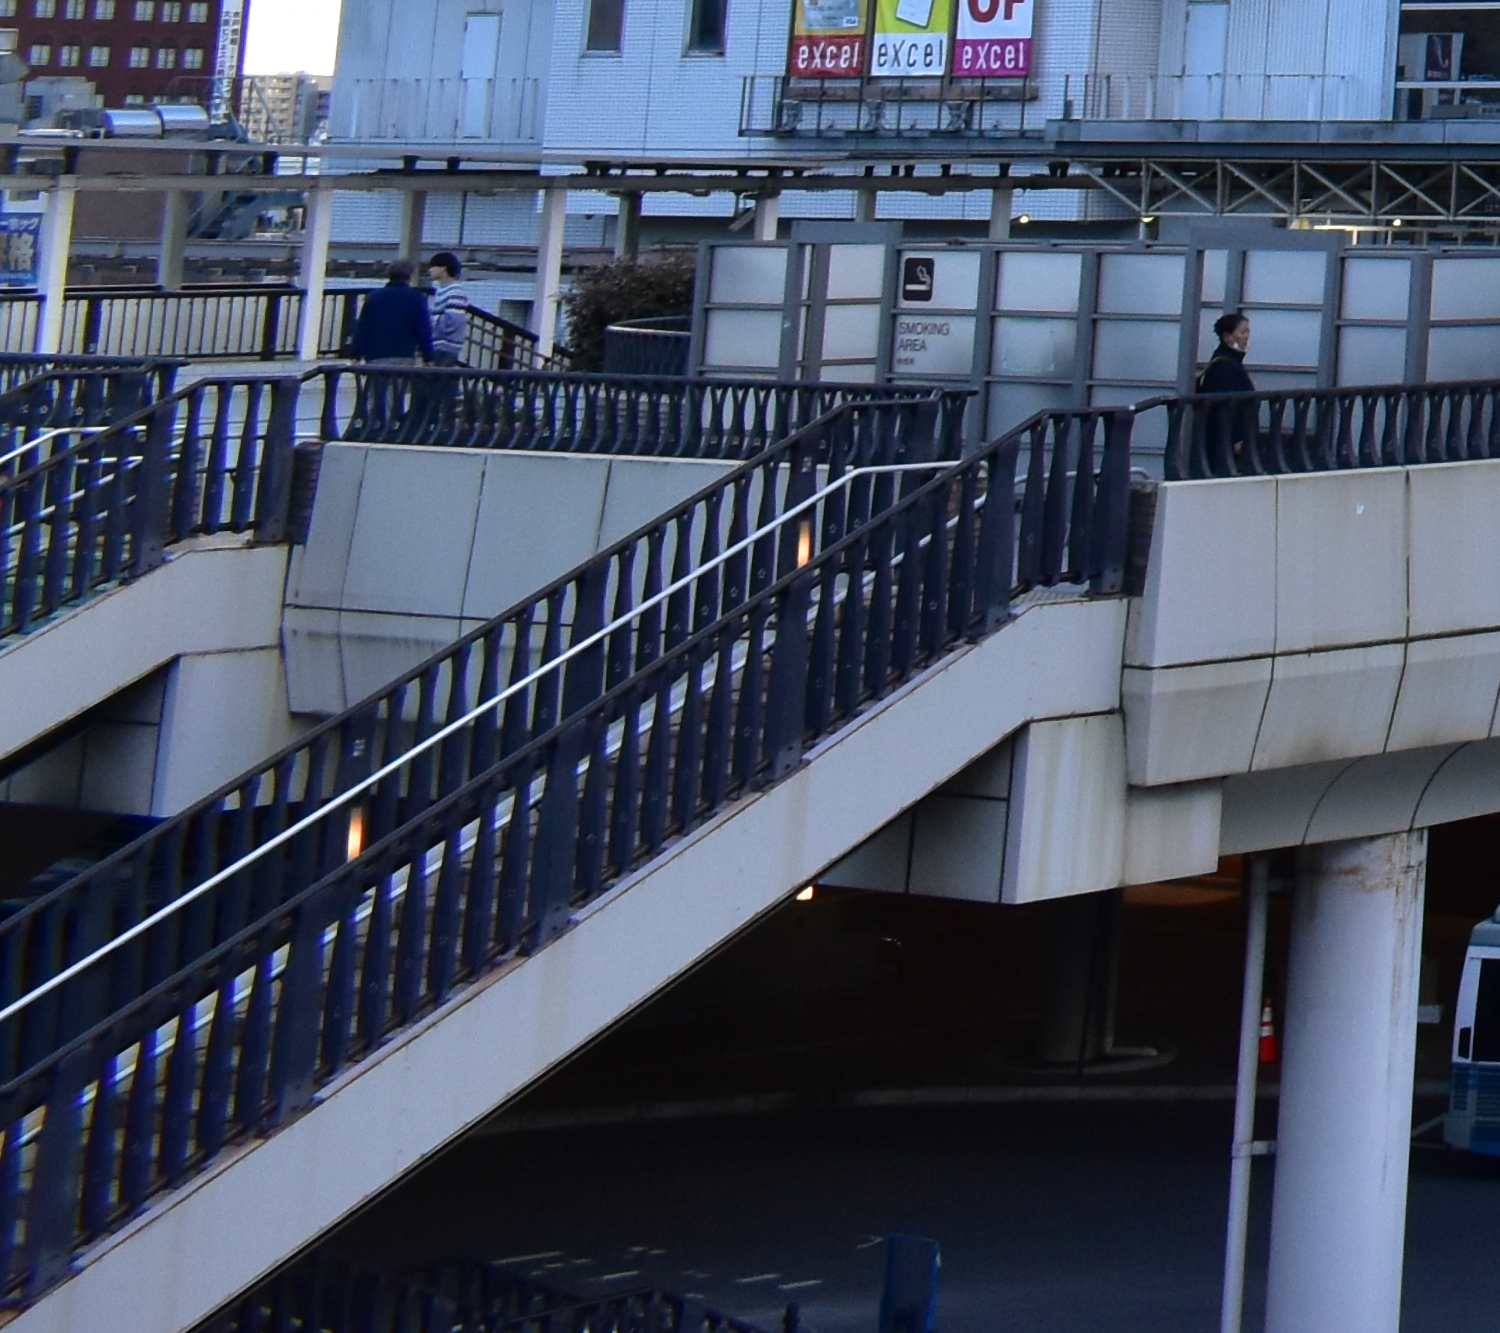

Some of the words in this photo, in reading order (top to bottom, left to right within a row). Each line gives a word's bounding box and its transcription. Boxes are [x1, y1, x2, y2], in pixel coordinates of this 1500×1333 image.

[797, 41, 859, 69] excel
[877, 39, 944, 68] excel
[962, 41, 1024, 70] excel
[900, 321, 950, 336] SMOKING
[898, 338, 927, 352] AREA
